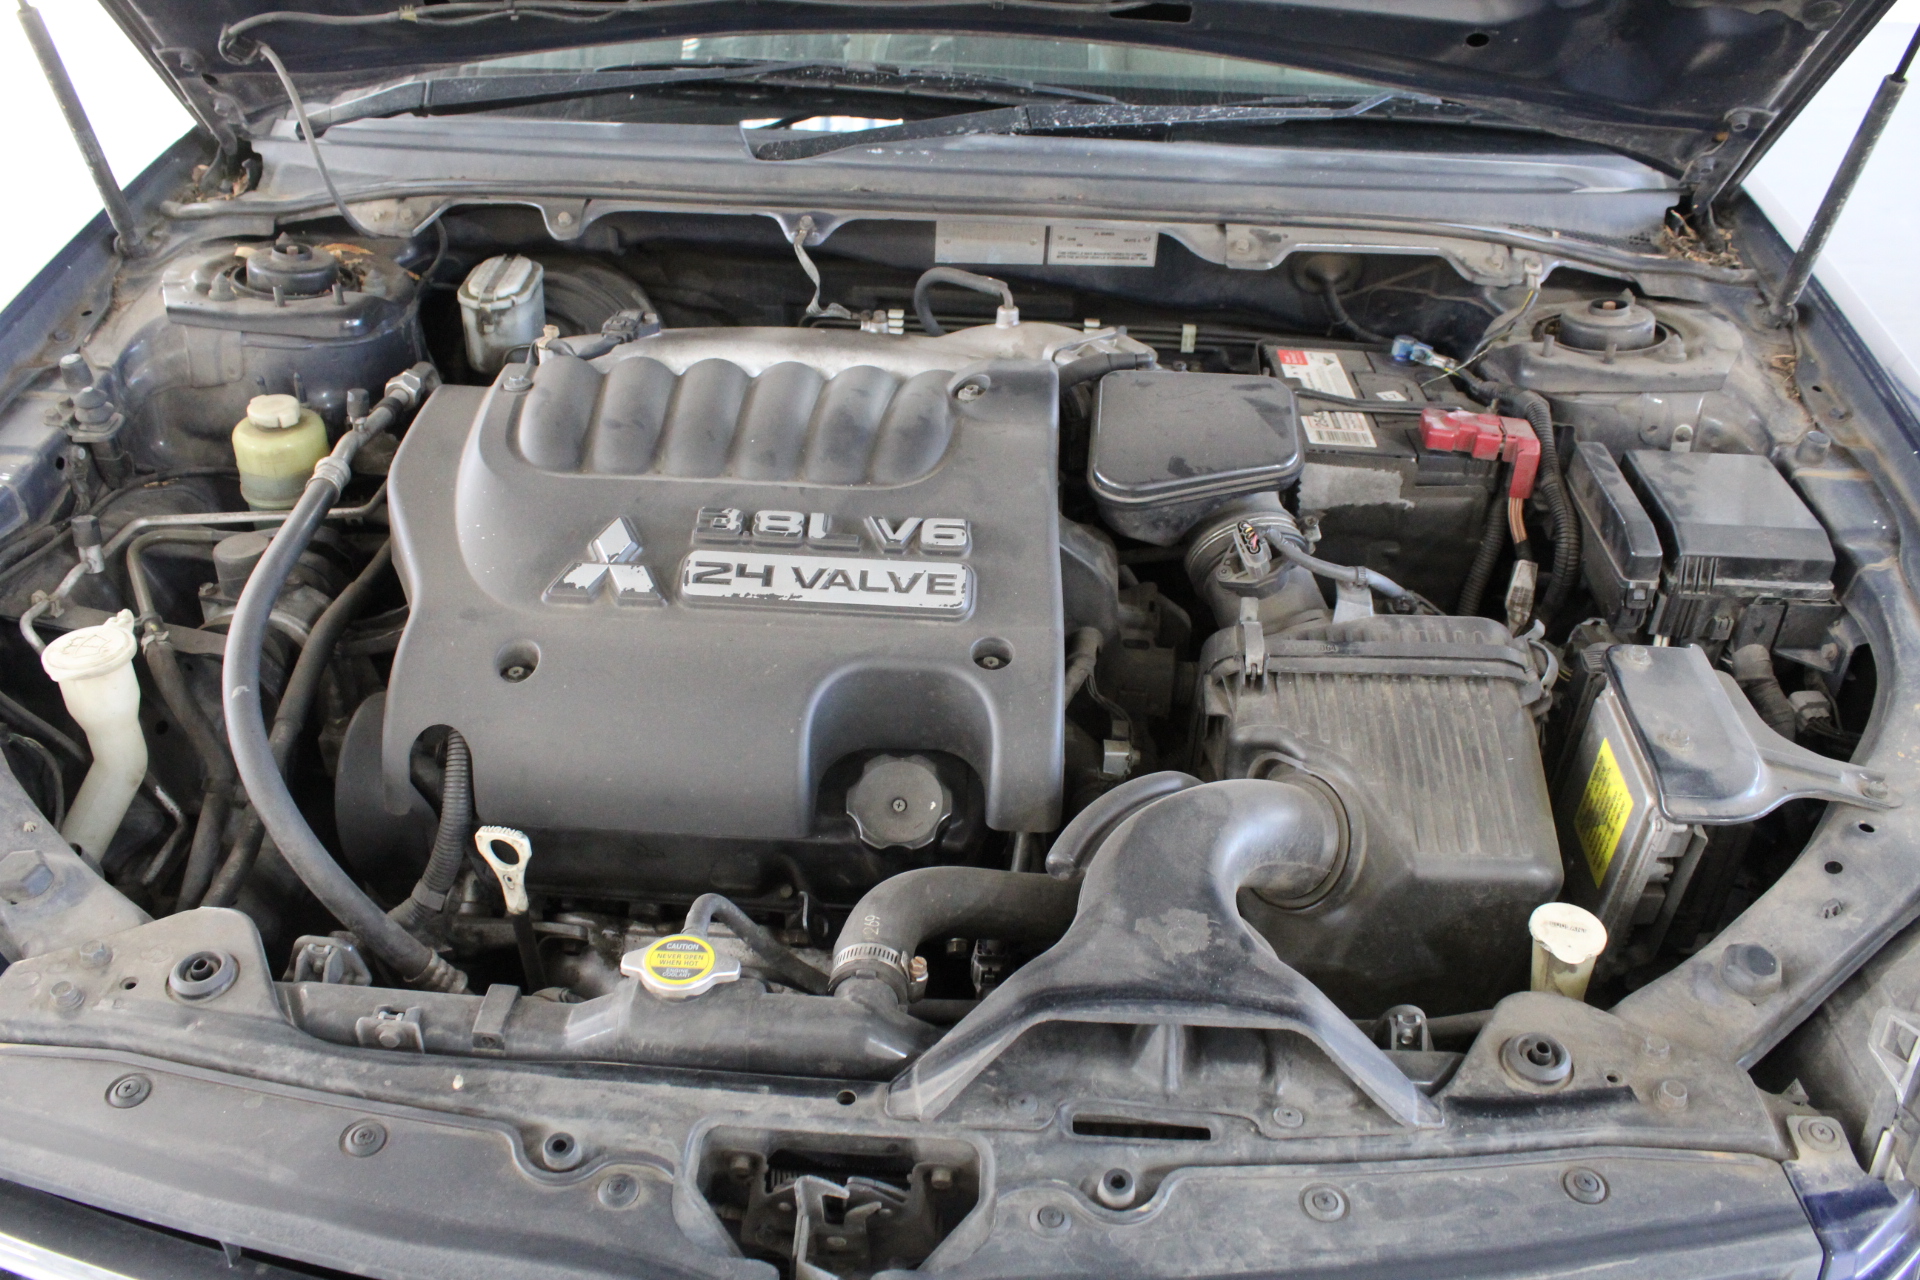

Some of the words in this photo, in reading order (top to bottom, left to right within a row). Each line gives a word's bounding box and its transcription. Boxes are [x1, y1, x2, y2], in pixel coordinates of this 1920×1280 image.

[865, 515, 972, 553] V6
[691, 560, 776, 588] 24
[791, 565, 959, 596] VALVE
